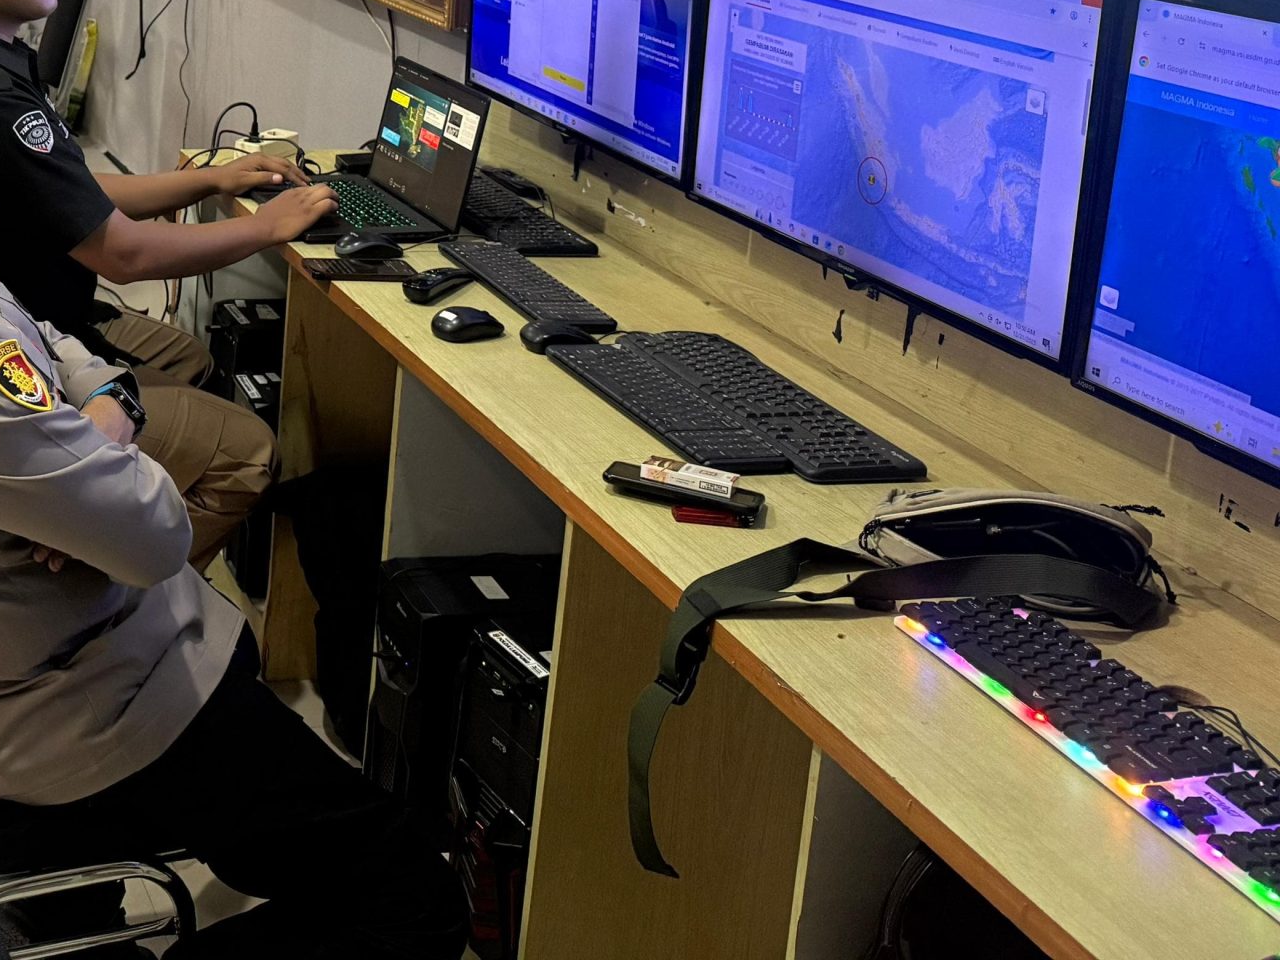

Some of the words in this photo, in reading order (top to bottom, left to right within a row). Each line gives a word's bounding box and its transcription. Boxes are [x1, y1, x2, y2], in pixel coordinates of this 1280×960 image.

[1173, 12, 1196, 24] MAGMA
[1197, 18, 1223, 29] Indonesia
[1167, 64, 1188, 76] Google
[1189, 69, 1212, 80] Chrome
[1161, 90, 1195, 107] MAGMA
[1196, 100, 1235, 117] Indonesia
[1126, 381, 1141, 396] Type
[1141, 389, 1156, 402] here
[1165, 401, 1185, 416] search
